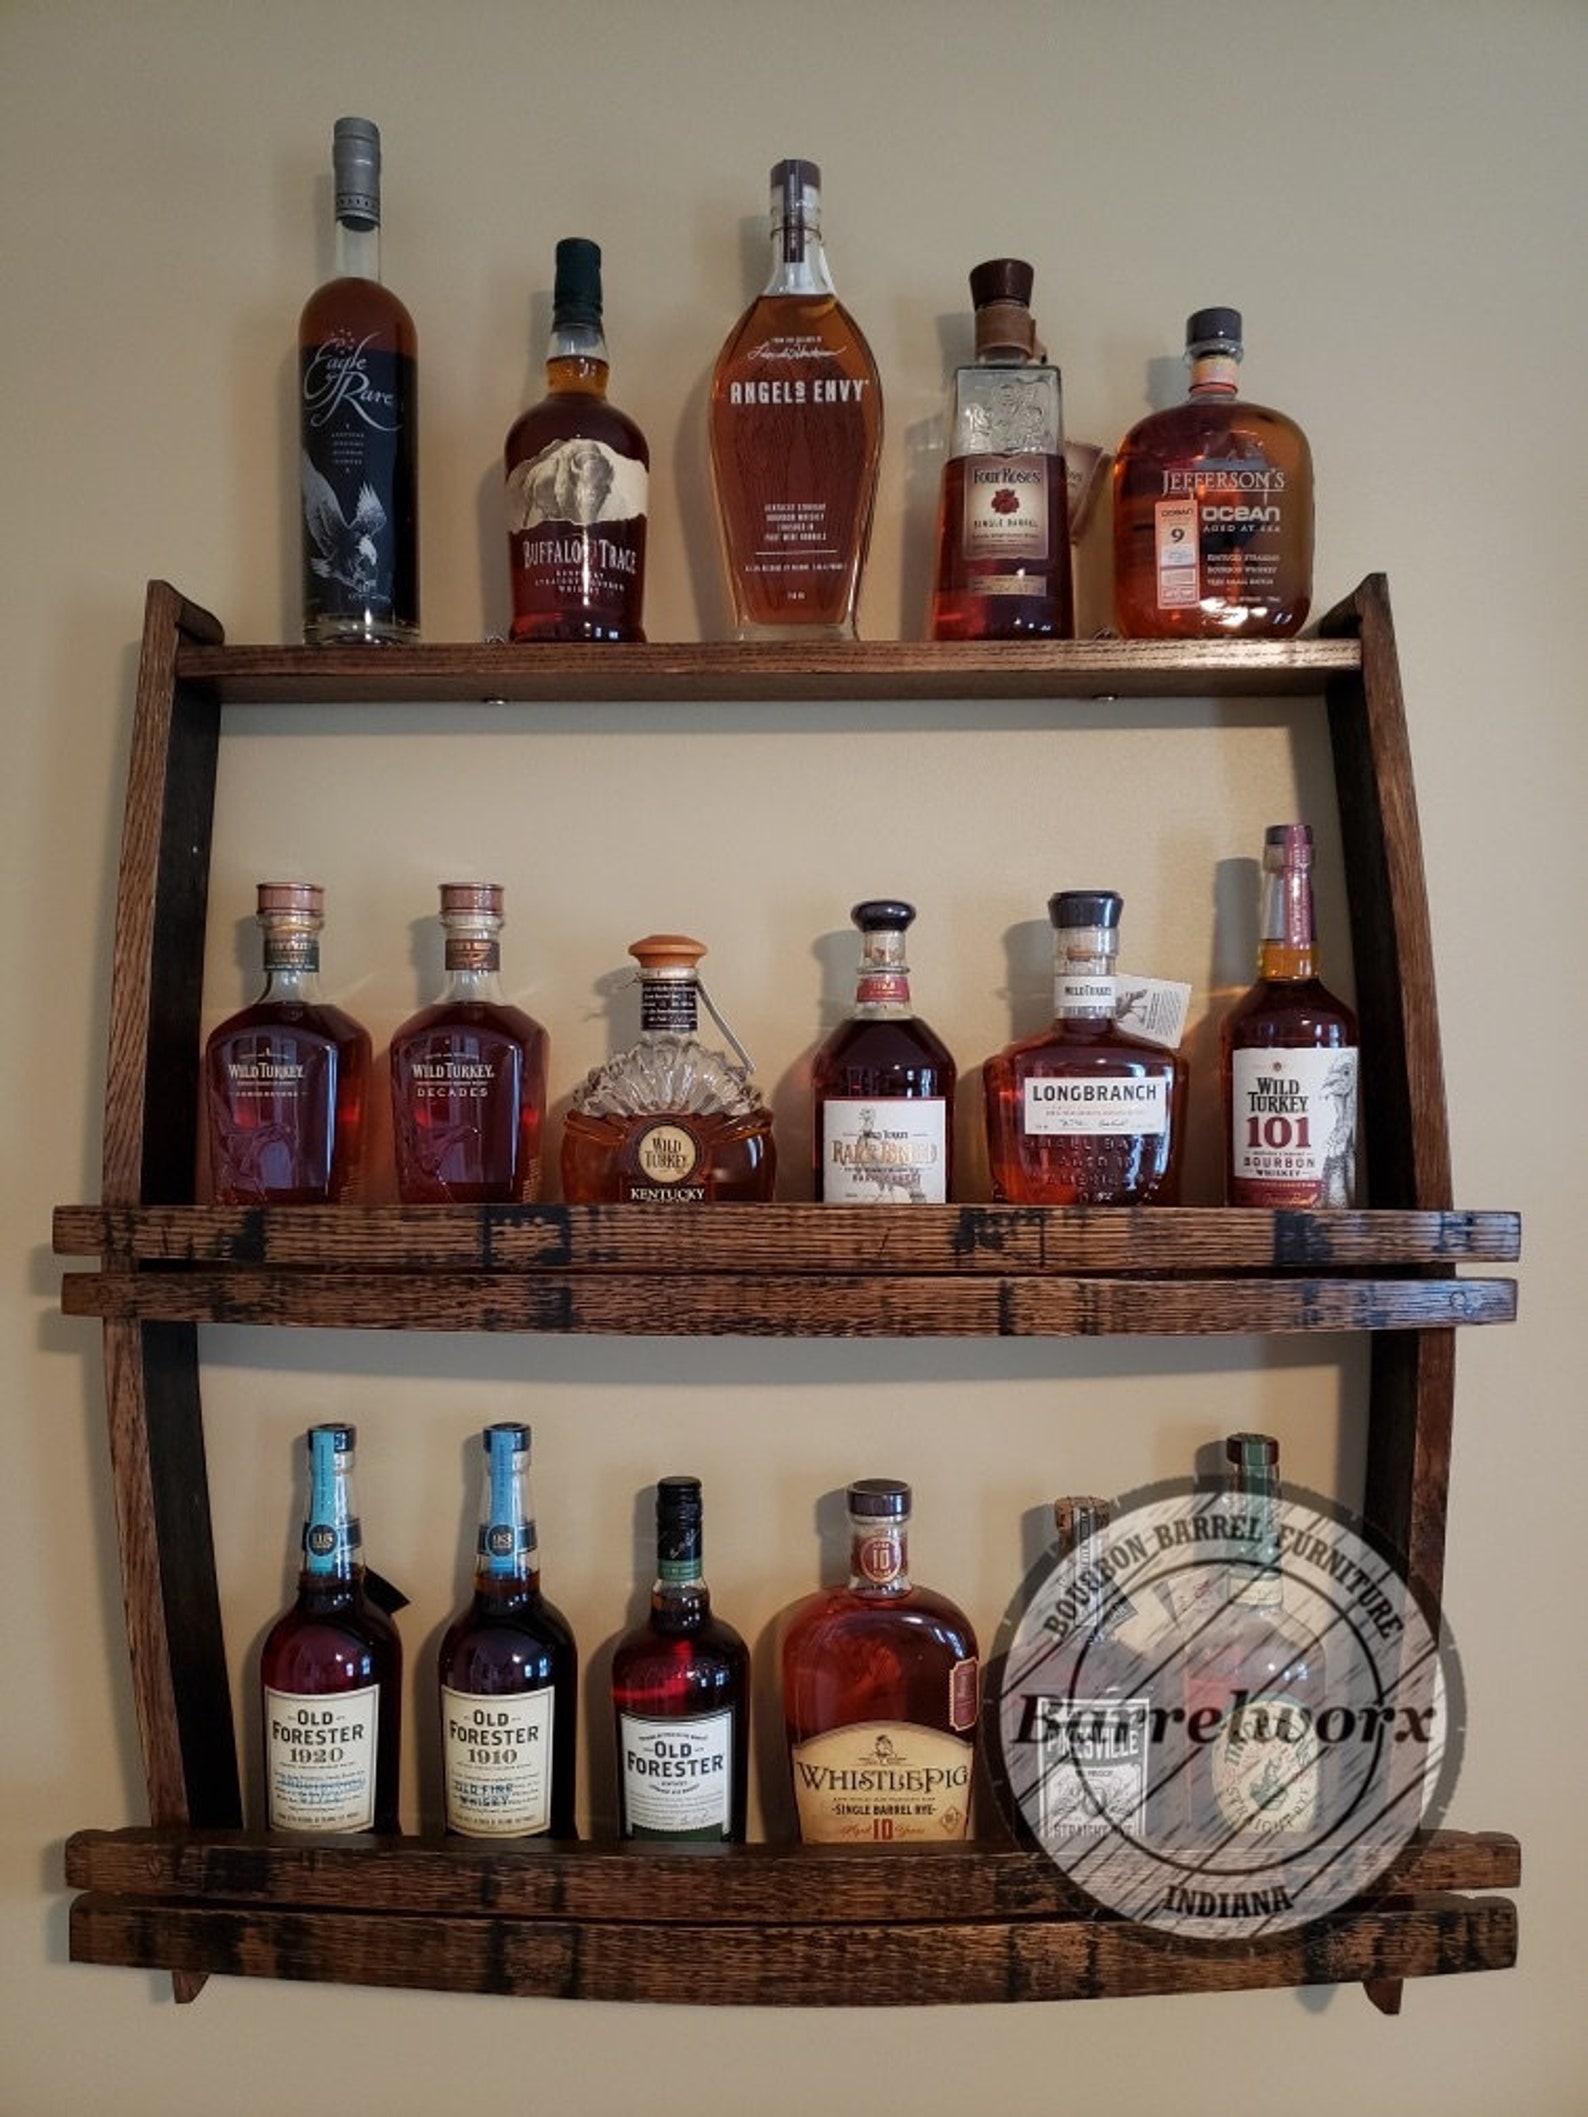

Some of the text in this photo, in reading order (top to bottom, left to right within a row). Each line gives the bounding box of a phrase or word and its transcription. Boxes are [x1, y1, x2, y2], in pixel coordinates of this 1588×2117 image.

[311, 370, 402, 430] Rare
[1162, 469, 1286, 496] JEFFERSON'S
[1171, 528, 1185, 543] 9
[1240, 524, 1255, 532] AT
[523, 539, 637, 575] BUFFALO TRACE
[228, 1062, 304, 1078] WILD TURKEY
[412, 1062, 494, 1078] WILD TURKEY
[417, 1087, 488, 1097] DECADES
[1032, 1085, 1157, 1101] LONGBRANCH
[1257, 1077, 1300, 1095] WILD
[1247, 1092, 1309, 1114] TURKEY
[1246, 1116, 1311, 1148] 101
[652, 1137, 682, 1153] WILD
[645, 1151, 687, 1168] TURKEY
[1244, 1156, 1316, 1168] BOURBON
[630, 1187, 705, 1200] KENTUCKY
[297, 1709, 333, 1725] OLD
[473, 1709, 509, 1727] OLD
[272, 1720, 364, 1746] FORESTER
[450, 1720, 539, 1746] FORESTER
[289, 1748, 344, 1764] 1920
[468, 1748, 518, 1765] 1910
[654, 1741, 692, 1758] OLD
[627, 1750, 724, 1777] FORESTER
[796, 1762, 969, 1794] WHISTLEPIG
[835, 1804, 934, 1815] SINGLE BARREL RYE
[873, 1818, 893, 1840] 10
